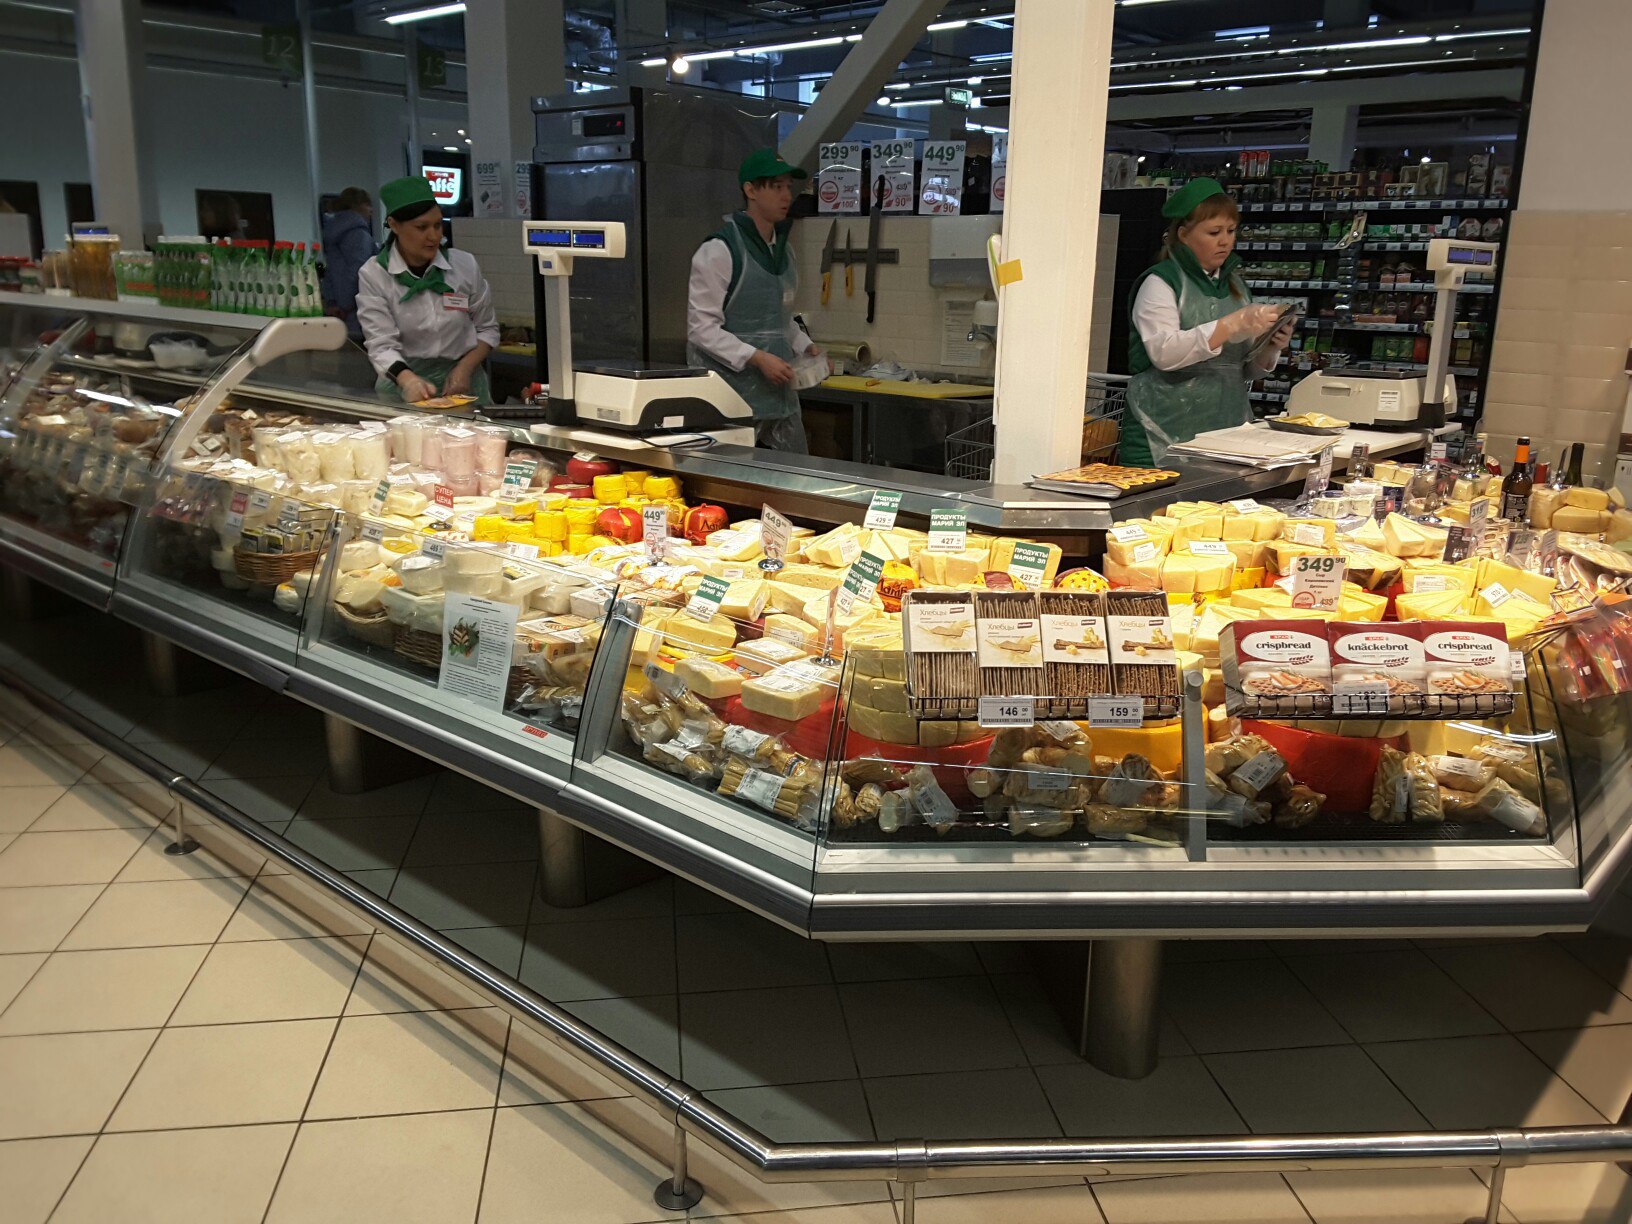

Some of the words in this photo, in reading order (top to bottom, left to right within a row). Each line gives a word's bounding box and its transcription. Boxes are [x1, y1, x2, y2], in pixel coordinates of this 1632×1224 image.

[266, 34, 296, 58] 12
[820, 146, 849, 160] 299
[872, 143, 903, 159] 349
[924, 145, 955, 162] 449
[955, 144, 965, 152] 90
[476, 162, 495, 174] 699
[895, 197, 906, 207] 90
[943, 203, 954, 213] 90
[436, 494, 452, 506] ЦЕНА
[873, 495, 901, 503] ПРОДУКТЫ
[644, 510, 661, 521] 449
[764, 512, 782, 528] 449
[1014, 547, 1049, 559] ПРОДУКТЫ
[859, 556, 882, 571] ПРОДУКТЫ
[1013, 553, 1036, 563] МАРИЙ
[1036, 557, 1047, 565] ЭЛ
[1297, 557, 1335, 572] 349
[858, 562, 874, 577] МАРИЙ
[872, 569, 881, 578] ЭЛ
[1019, 572, 1032, 581] 427
[699, 585, 716, 596] МАРИЙ
[702, 578, 728, 593] ПРОДУКТЫ
[919, 608, 947, 616] Хлебцы
[987, 623, 1015, 631] Хлебцы
[1051, 619, 1078, 627] Хлебцы
[1119, 620, 1146, 628] Хлебцы
[1256, 641, 1312, 650] crispbread
[1347, 643, 1409, 651] knäckebrot
[1438, 642, 1493, 651] crispbread
[1000, 707, 1018, 716] 146
[1109, 707, 1128, 717] 159
